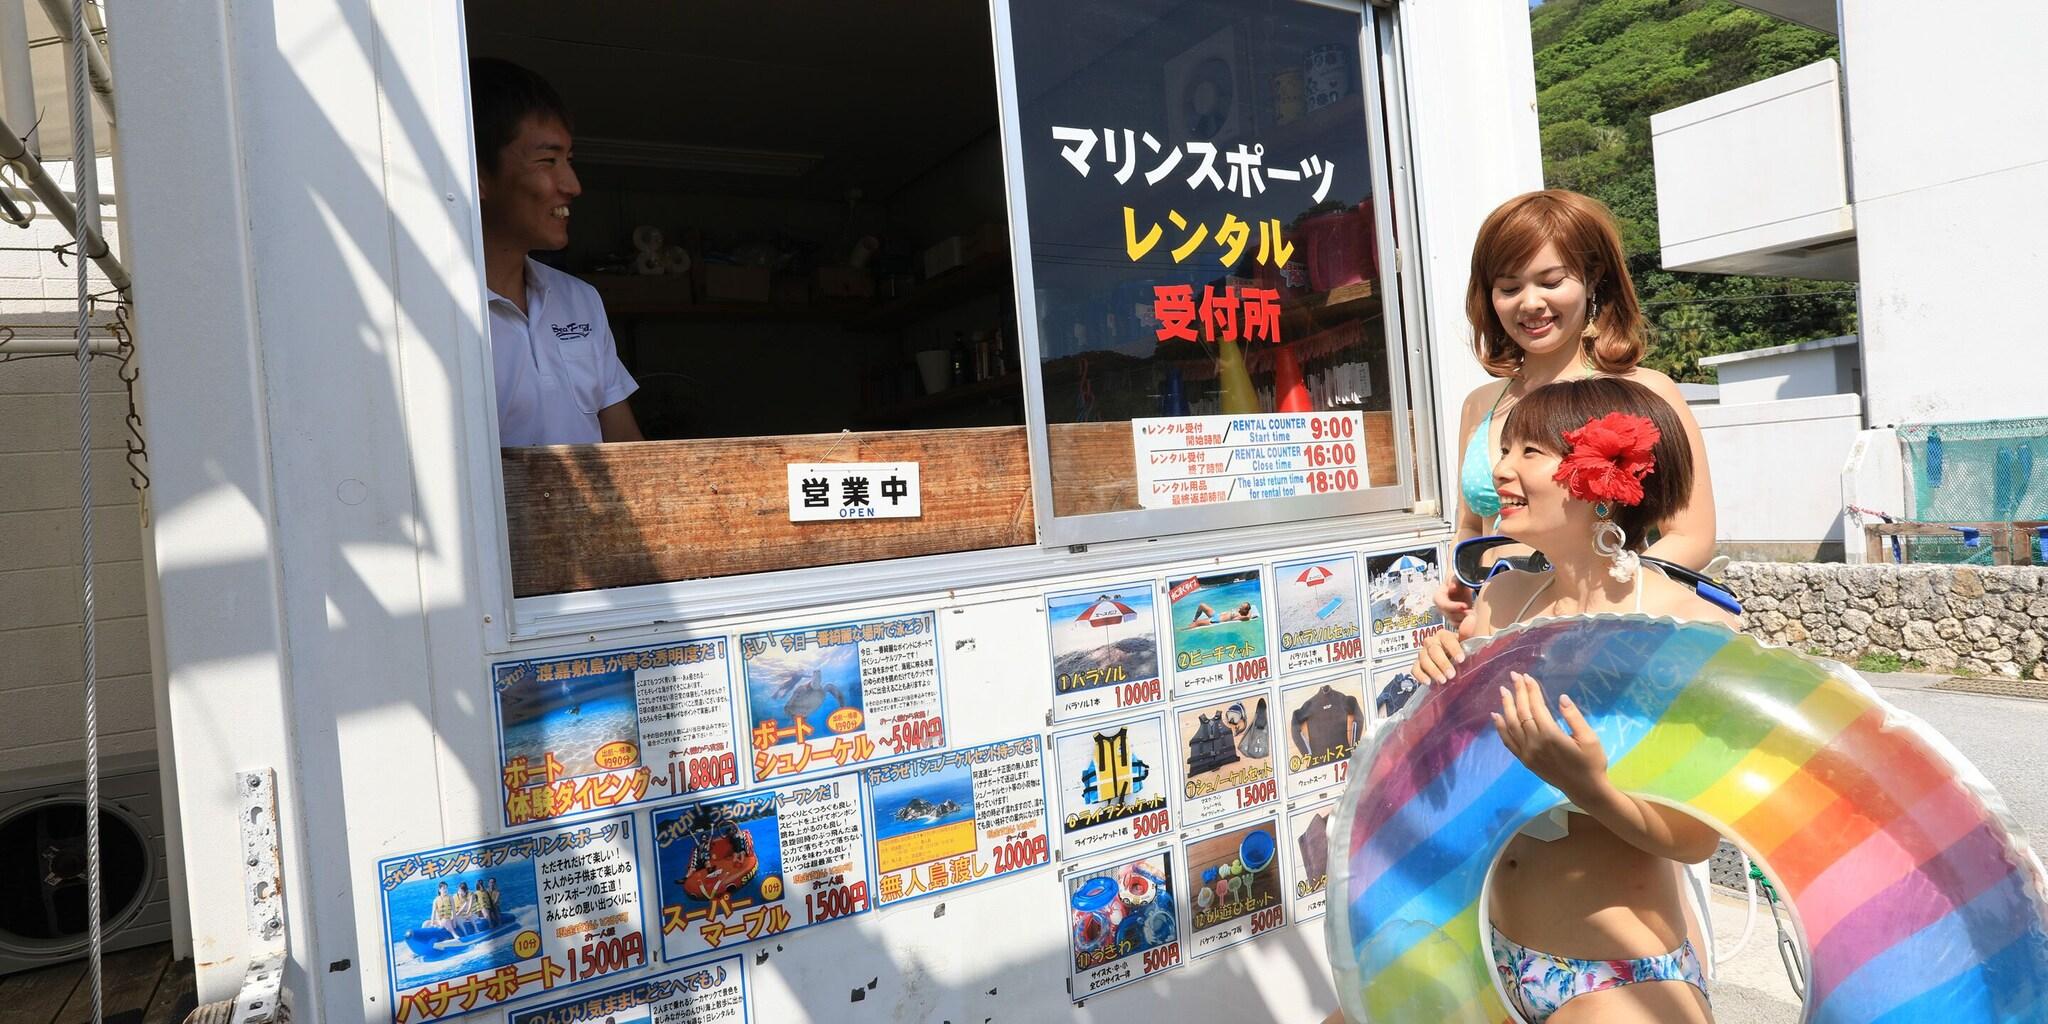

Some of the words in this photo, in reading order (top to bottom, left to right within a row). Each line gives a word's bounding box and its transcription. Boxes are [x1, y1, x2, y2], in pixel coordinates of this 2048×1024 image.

[1052, 126, 1335, 204] マリンスポーツ
[1124, 206, 1294, 269] レンタル
[1153, 284, 1281, 343] 受付所
[1147, 423, 1203, 435] レンタル受付
[1233, 419, 1267, 431] RENTAL
[1269, 418, 1306, 430] COUNTER
[1249, 432, 1271, 442] Start
[1273, 431, 1290, 442] time
[1311, 416, 1353, 440] 9:00
[1185, 435, 1222, 446] 開始時間
[1235, 448, 1266, 460] RENTAL
[1267, 446, 1301, 458] COUNTER
[1304, 443, 1356, 467] 16:00
[1150, 452, 1205, 465] レンタル受付
[1188, 463, 1224, 475] 終了時間
[1252, 460, 1274, 471] Close
[1276, 460, 1292, 470] time
[801, 475, 908, 508] 営業中
[1152, 482, 1208, 494] レンタル用品
[1238, 479, 1251, 489] The
[1253, 477, 1266, 488] last
[1267, 476, 1288, 487] return
[1289, 474, 1304, 485] time
[1249, 489, 1260, 500] for
[1261, 488, 1281, 499] rental
[1282, 486, 1295, 497] tool
[1306, 469, 1358, 494] 18:00
[839, 508, 875, 518] OPEN
[1228, 656, 1268, 684] 1,000円
[1065, 698, 1101, 711] パラソル1本
[1115, 678, 1161, 708] 1,000円
[753, 715, 815, 750] ボート
[503, 752, 565, 789] ボート
[755, 734, 875, 780] シュノーケル
[506, 766, 652, 824] 体験ダイビング
[710, 782, 840, 823] うちのナンバーワンだ！
[1236, 778, 1277, 809] 1,500円
[1133, 809, 1170, 839] 500円
[541, 848, 621, 875] ただそれだけで楽しい！
[993, 834, 1048, 874] 2,000円
[543, 861, 633, 891] 大人から子供まで楽しめる
[764, 884, 781, 893] 10分
[879, 854, 989, 903] 無人島渡し
[544, 880, 623, 905] マリンスポーツの王道！
[545, 891, 638, 922] みんなとの思い出づくりに！
[663, 895, 753, 936] スーパー
[701, 904, 791, 948] マーブル
[1250, 904, 1283, 935] 500円
[516, 937, 537, 950] 10分
[567, 931, 645, 982] 1,500円
[1143, 942, 1180, 974] 500円
[394, 955, 566, 1024] バナナボート
